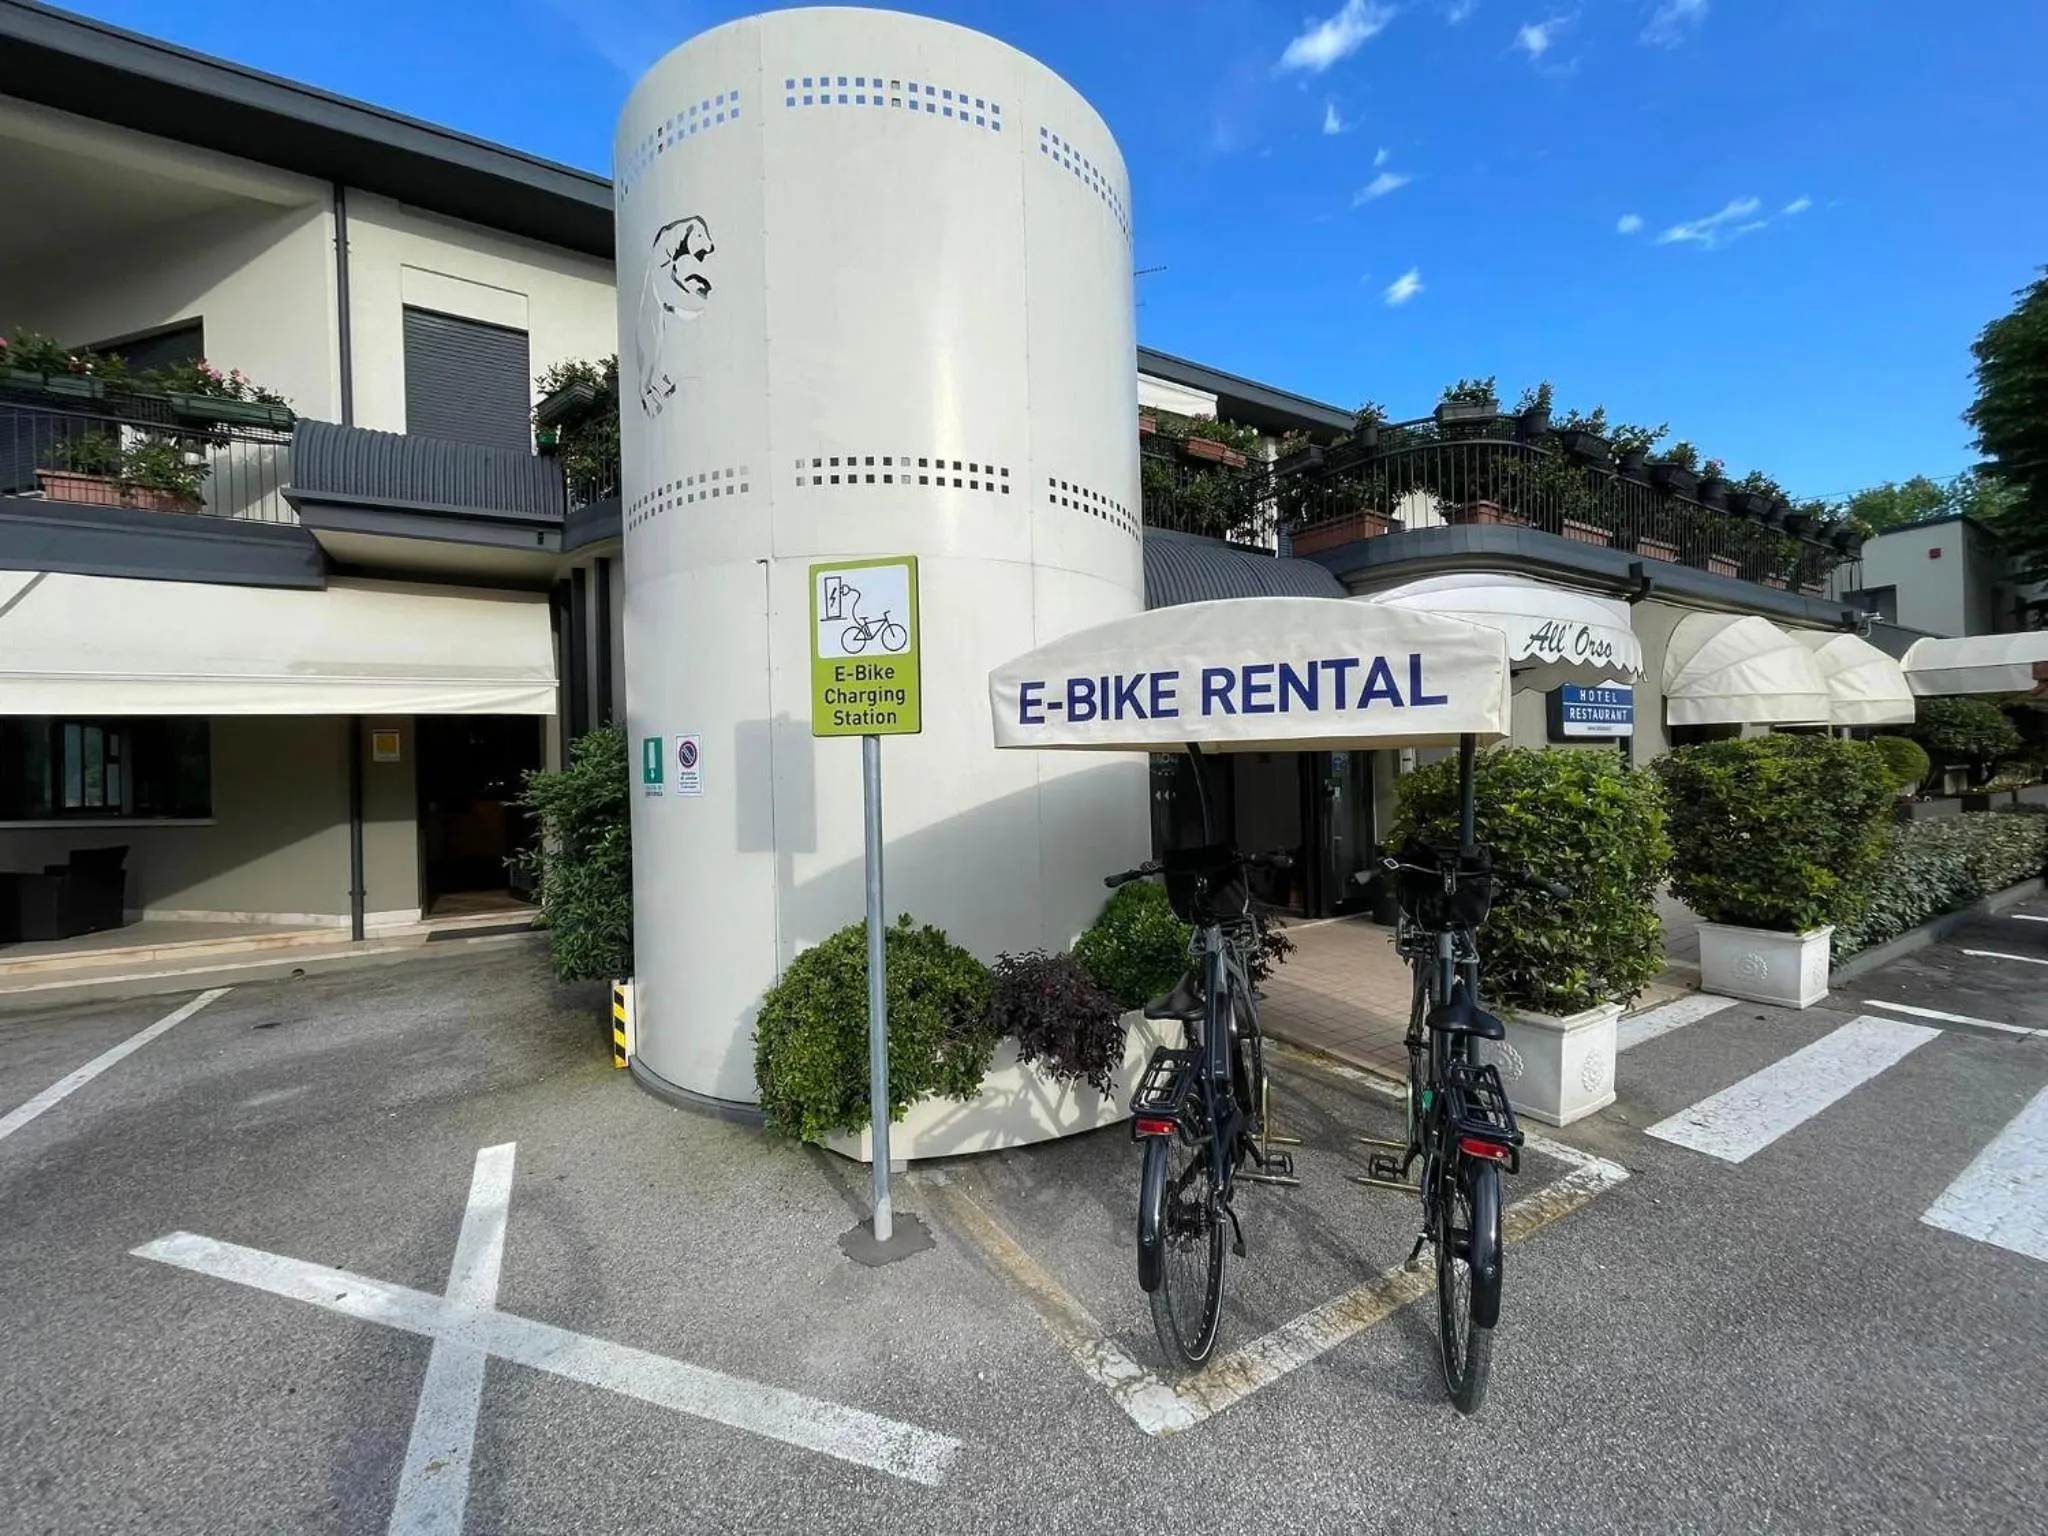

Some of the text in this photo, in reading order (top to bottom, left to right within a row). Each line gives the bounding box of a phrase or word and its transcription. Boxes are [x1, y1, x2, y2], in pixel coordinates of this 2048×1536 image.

[834, 664, 895, 682] E-Bike
[824, 686, 905, 706] Charging
[1018, 653, 1449, 726] E-BIKE RENTAL
[1579, 689, 1618, 704] HOTEL
[833, 708, 897, 726] Station
[1569, 706, 1628, 722] RESTAURANT
